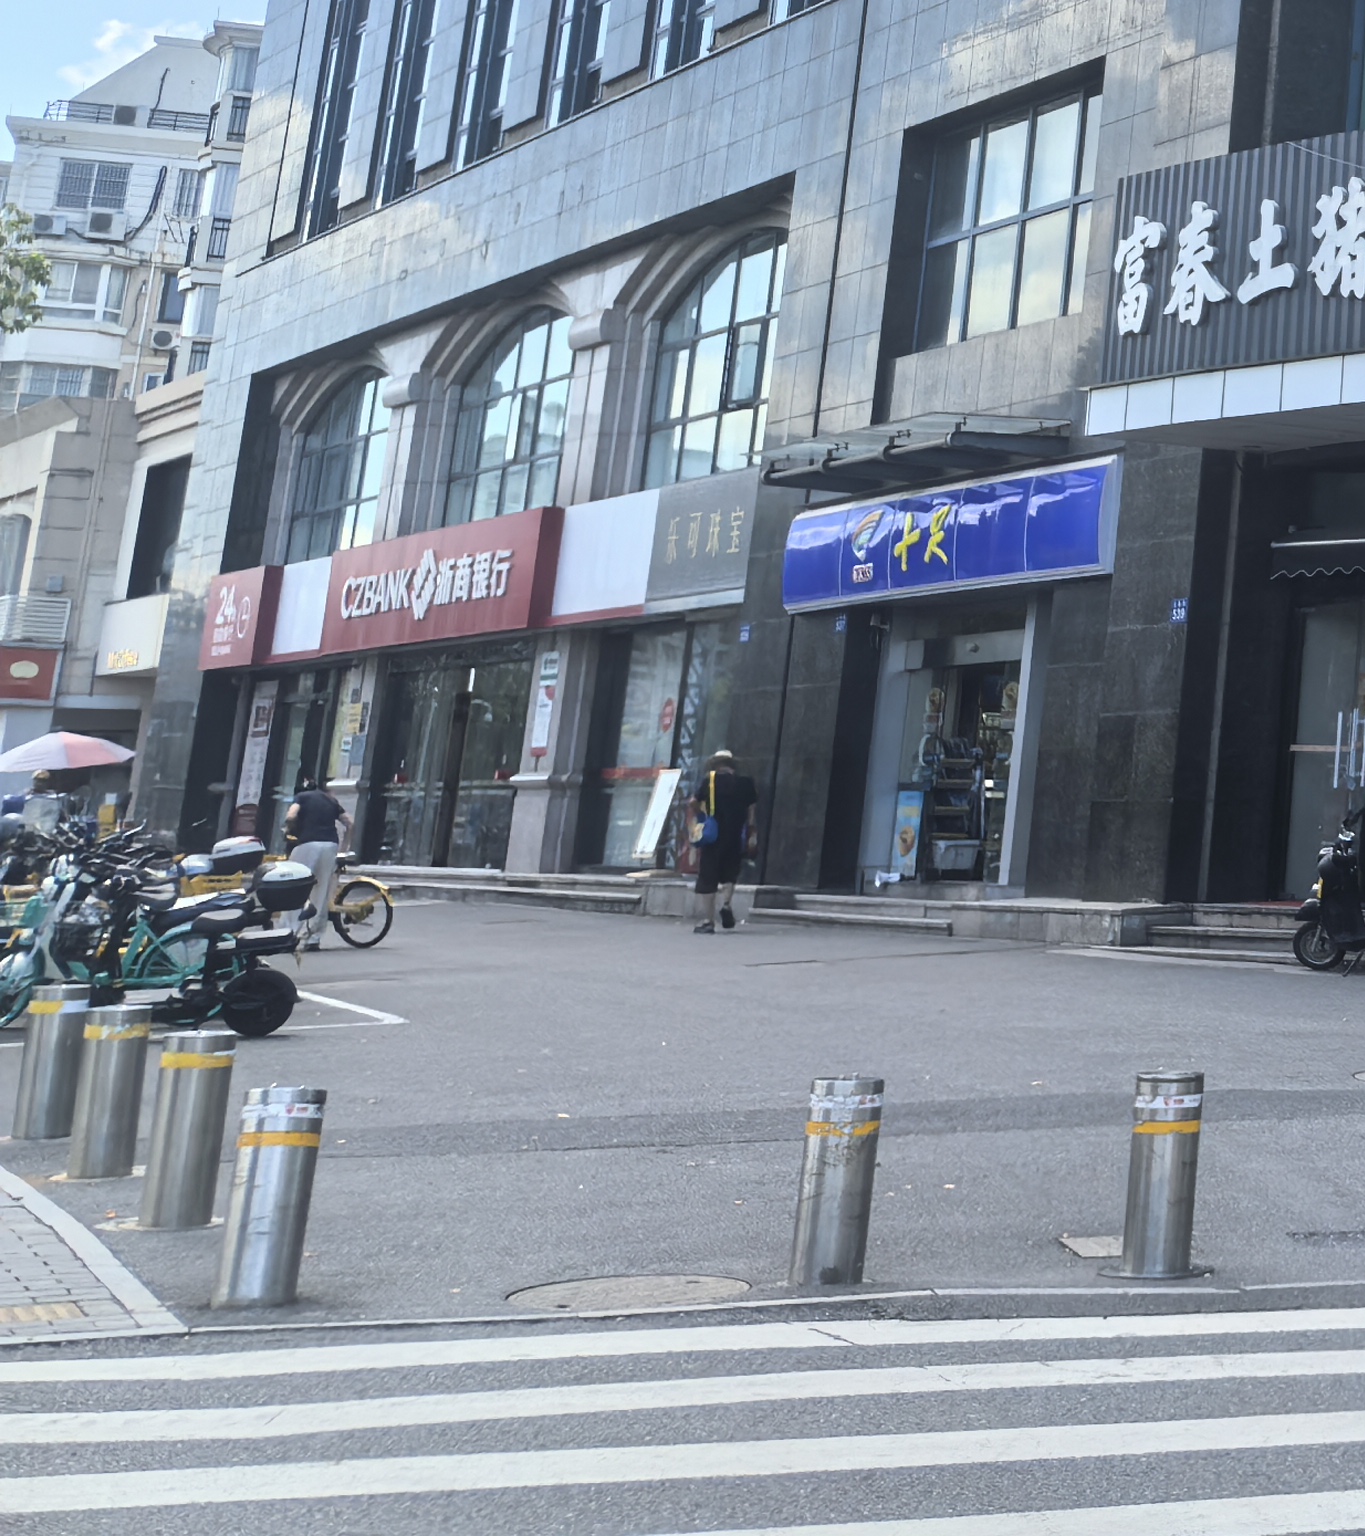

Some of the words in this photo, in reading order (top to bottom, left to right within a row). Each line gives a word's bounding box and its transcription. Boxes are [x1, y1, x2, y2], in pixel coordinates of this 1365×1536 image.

[893, 504, 952, 572] 十足
[341, 568, 412, 620] CZBANK
[433, 549, 513, 605] 浙商银行
